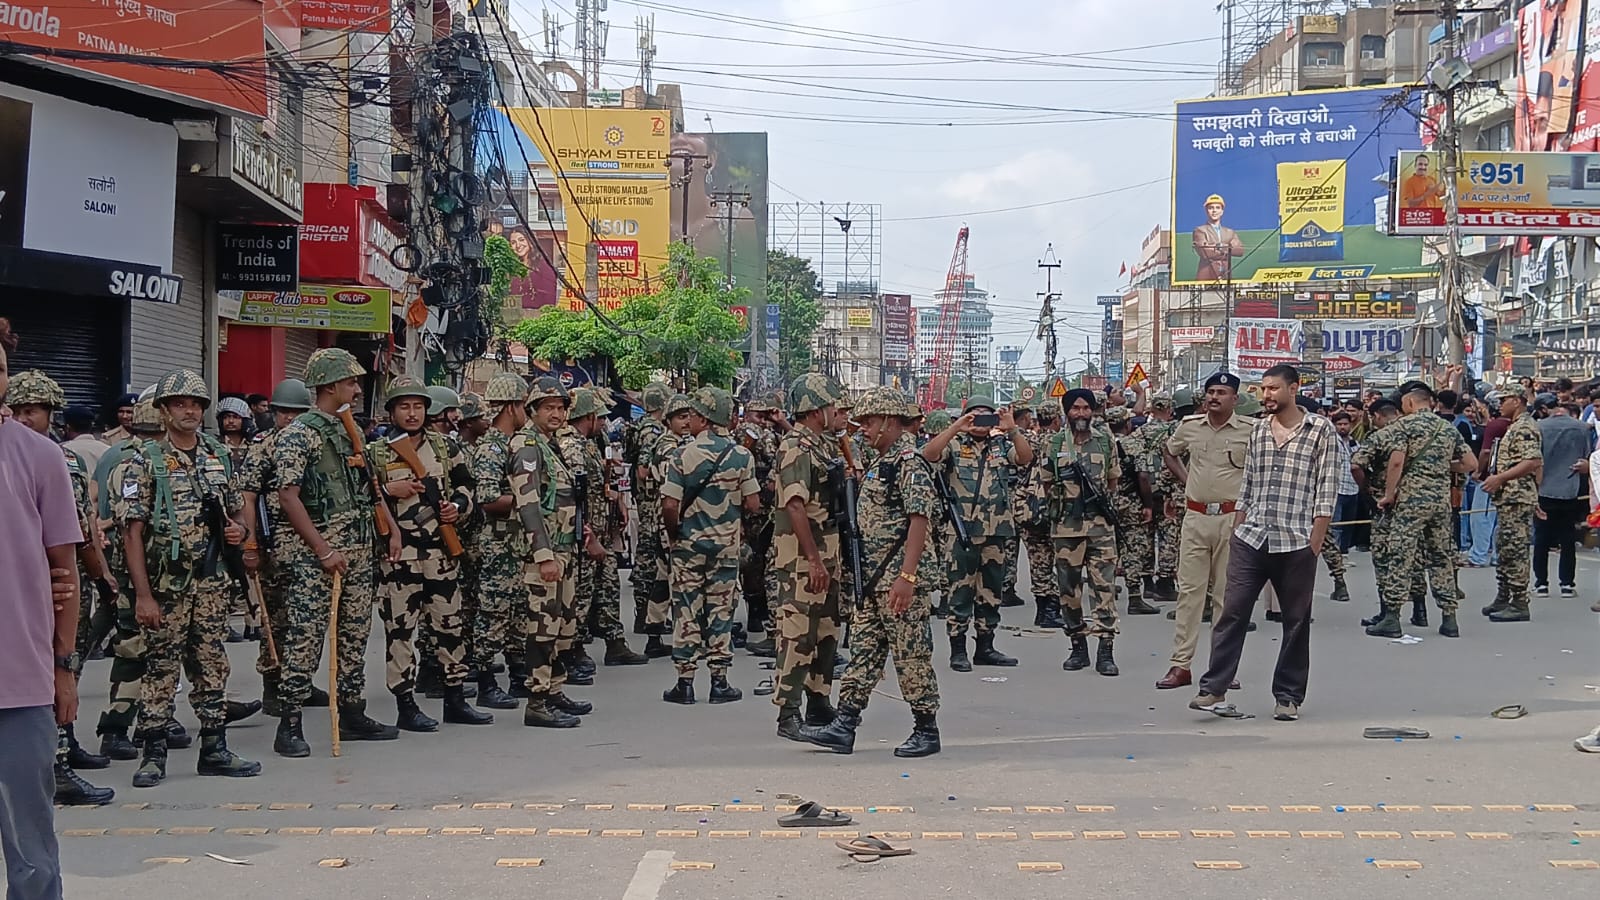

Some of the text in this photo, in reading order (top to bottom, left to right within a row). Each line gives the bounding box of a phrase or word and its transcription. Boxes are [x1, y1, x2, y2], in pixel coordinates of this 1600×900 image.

[144, 4, 177, 28] शाखा
[78, 31, 116, 54] PATNA
[1192, 104, 1334, 132] समझदारी दिखाओ,
[1192, 125, 1357, 153] मजबूती को सीलन से बचाओ
[557, 148, 668, 160] SHYAM STEEL
[87, 175, 117, 194] सलोनी
[576, 184, 648, 195] FLEXI STRONG MATLAB
[1285, 184, 1338, 197] UltraTech
[603, 196, 613, 205] KE
[613, 196, 628, 205] LIYE
[628, 197, 654, 206] STRONG
[1471, 194, 1484, 202] AC
[84, 200, 117, 215] SALONI
[1319, 204, 1337, 212] PLUS
[298, 225, 350, 234] ERICAN
[592, 218, 639, 237] 50D
[222, 234, 293, 250] Trends of
[300, 233, 349, 242] RISTER
[597, 245, 635, 257] RIMARY
[237, 251, 277, 267] India
[597, 261, 633, 272] STEEL
[109, 270, 179, 304] SALONI
[566, 287, 618, 298] BUING
[1255, 292, 1278, 300] TECH
[1318, 301, 1402, 314] HITECH
[1235, 327, 1405, 353] ALFA OLUTIO
[1023, 389, 1033, 397] 20
